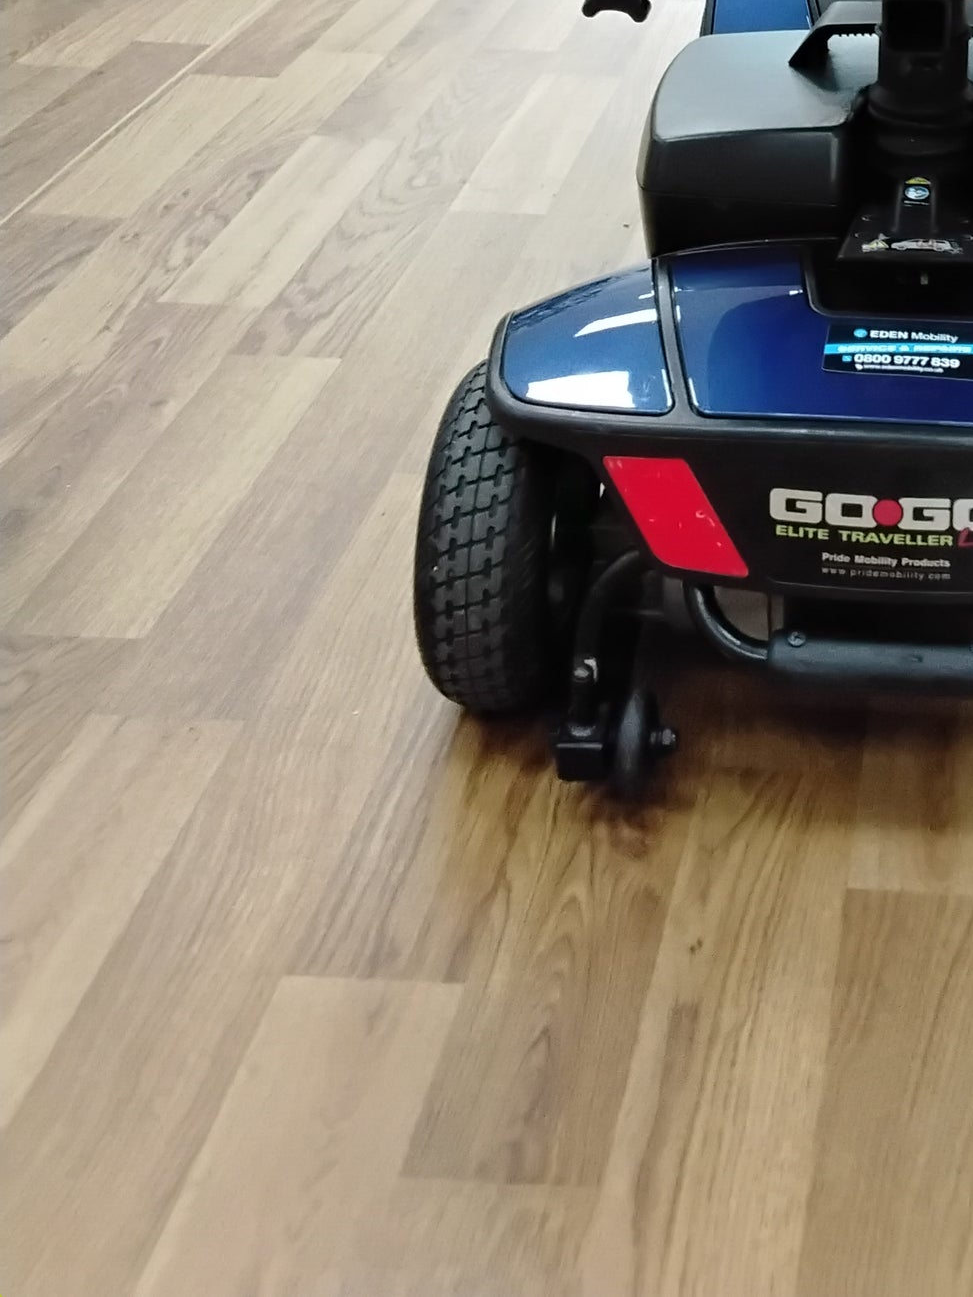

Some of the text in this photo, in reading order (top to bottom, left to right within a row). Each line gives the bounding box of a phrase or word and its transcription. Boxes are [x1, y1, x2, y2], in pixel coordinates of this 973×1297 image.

[869, 329, 959, 344] EDEN Mobility
[854, 353, 961, 369] 0800 9777 839
[775, 524, 829, 540] ELITE
[838, 529, 954, 547] TRAVELLER
[821, 552, 951, 568] Pride Mobility Products
